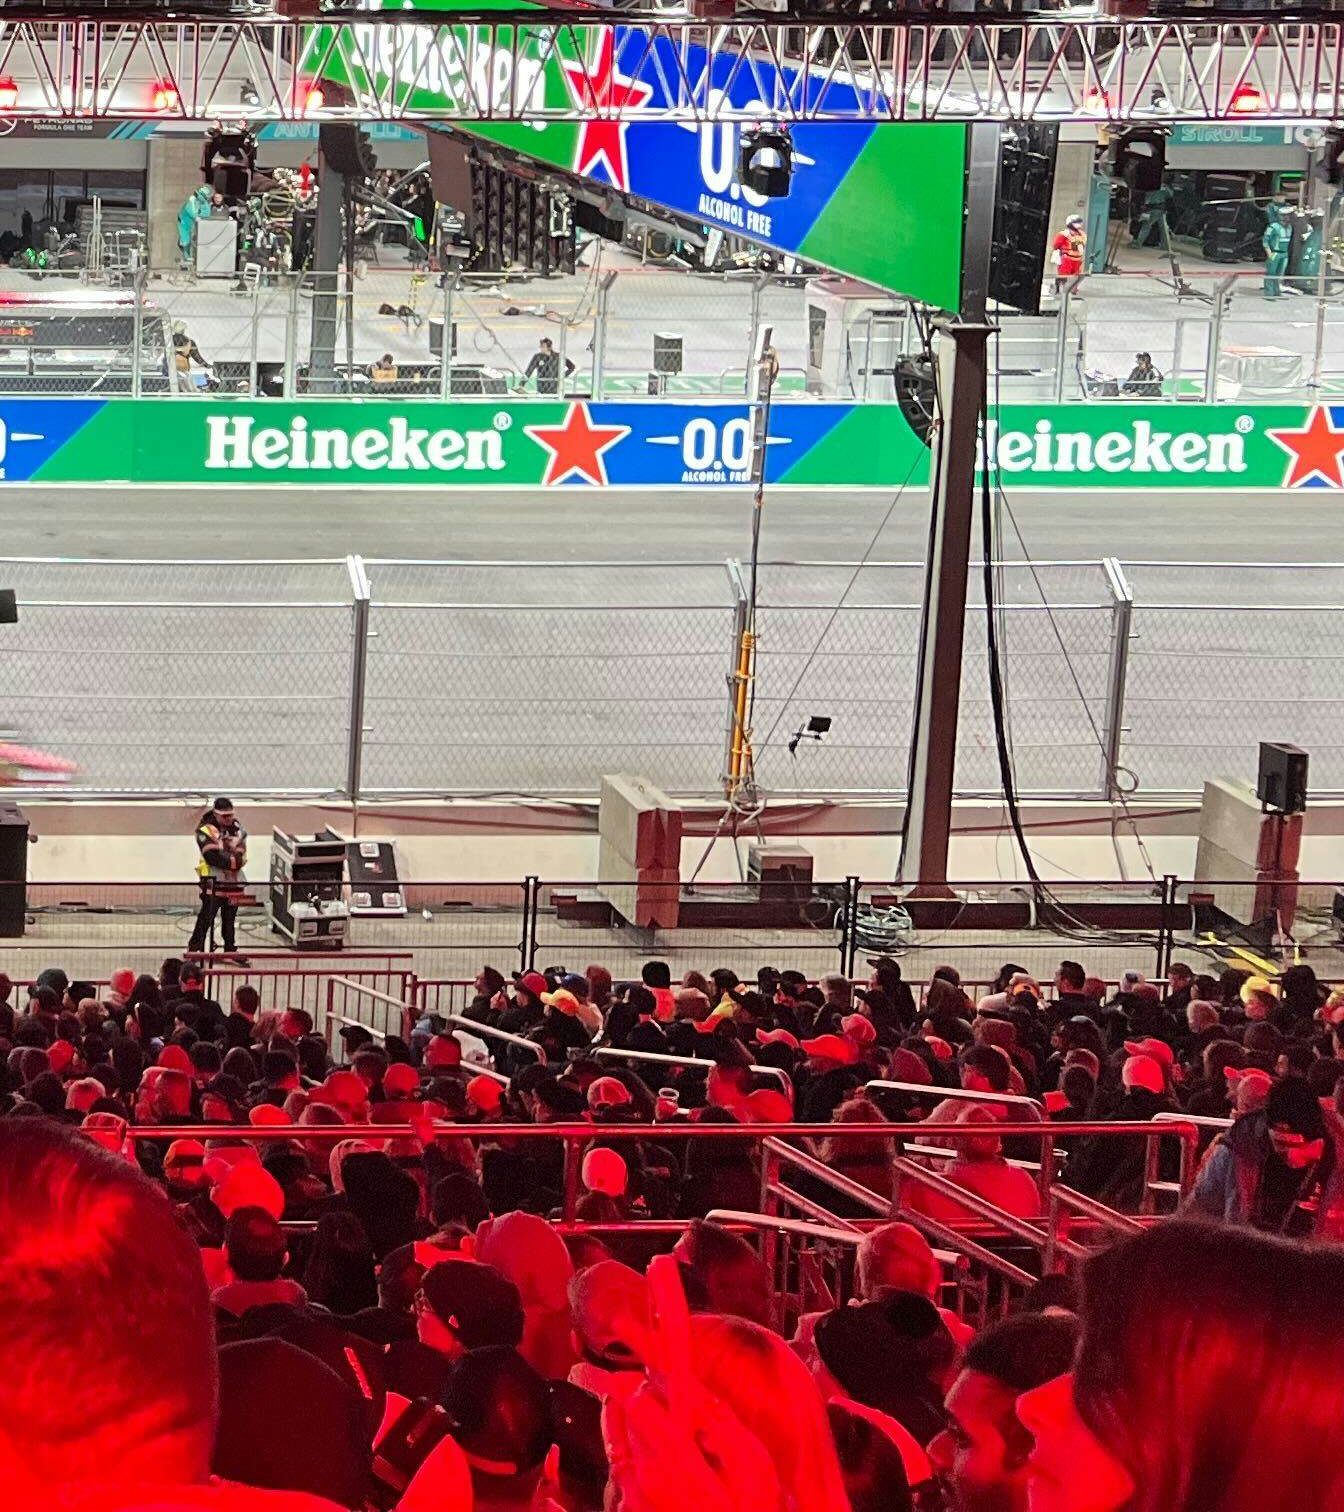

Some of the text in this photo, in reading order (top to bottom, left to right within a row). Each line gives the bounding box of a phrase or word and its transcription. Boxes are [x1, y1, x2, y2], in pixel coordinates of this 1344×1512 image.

[1181, 125, 1264, 143] STROLL
[698, 193, 772, 238] ALCOHOL FREE
[682, 417, 753, 470] 0.0
[681, 470, 726, 483] ALCOHOL
